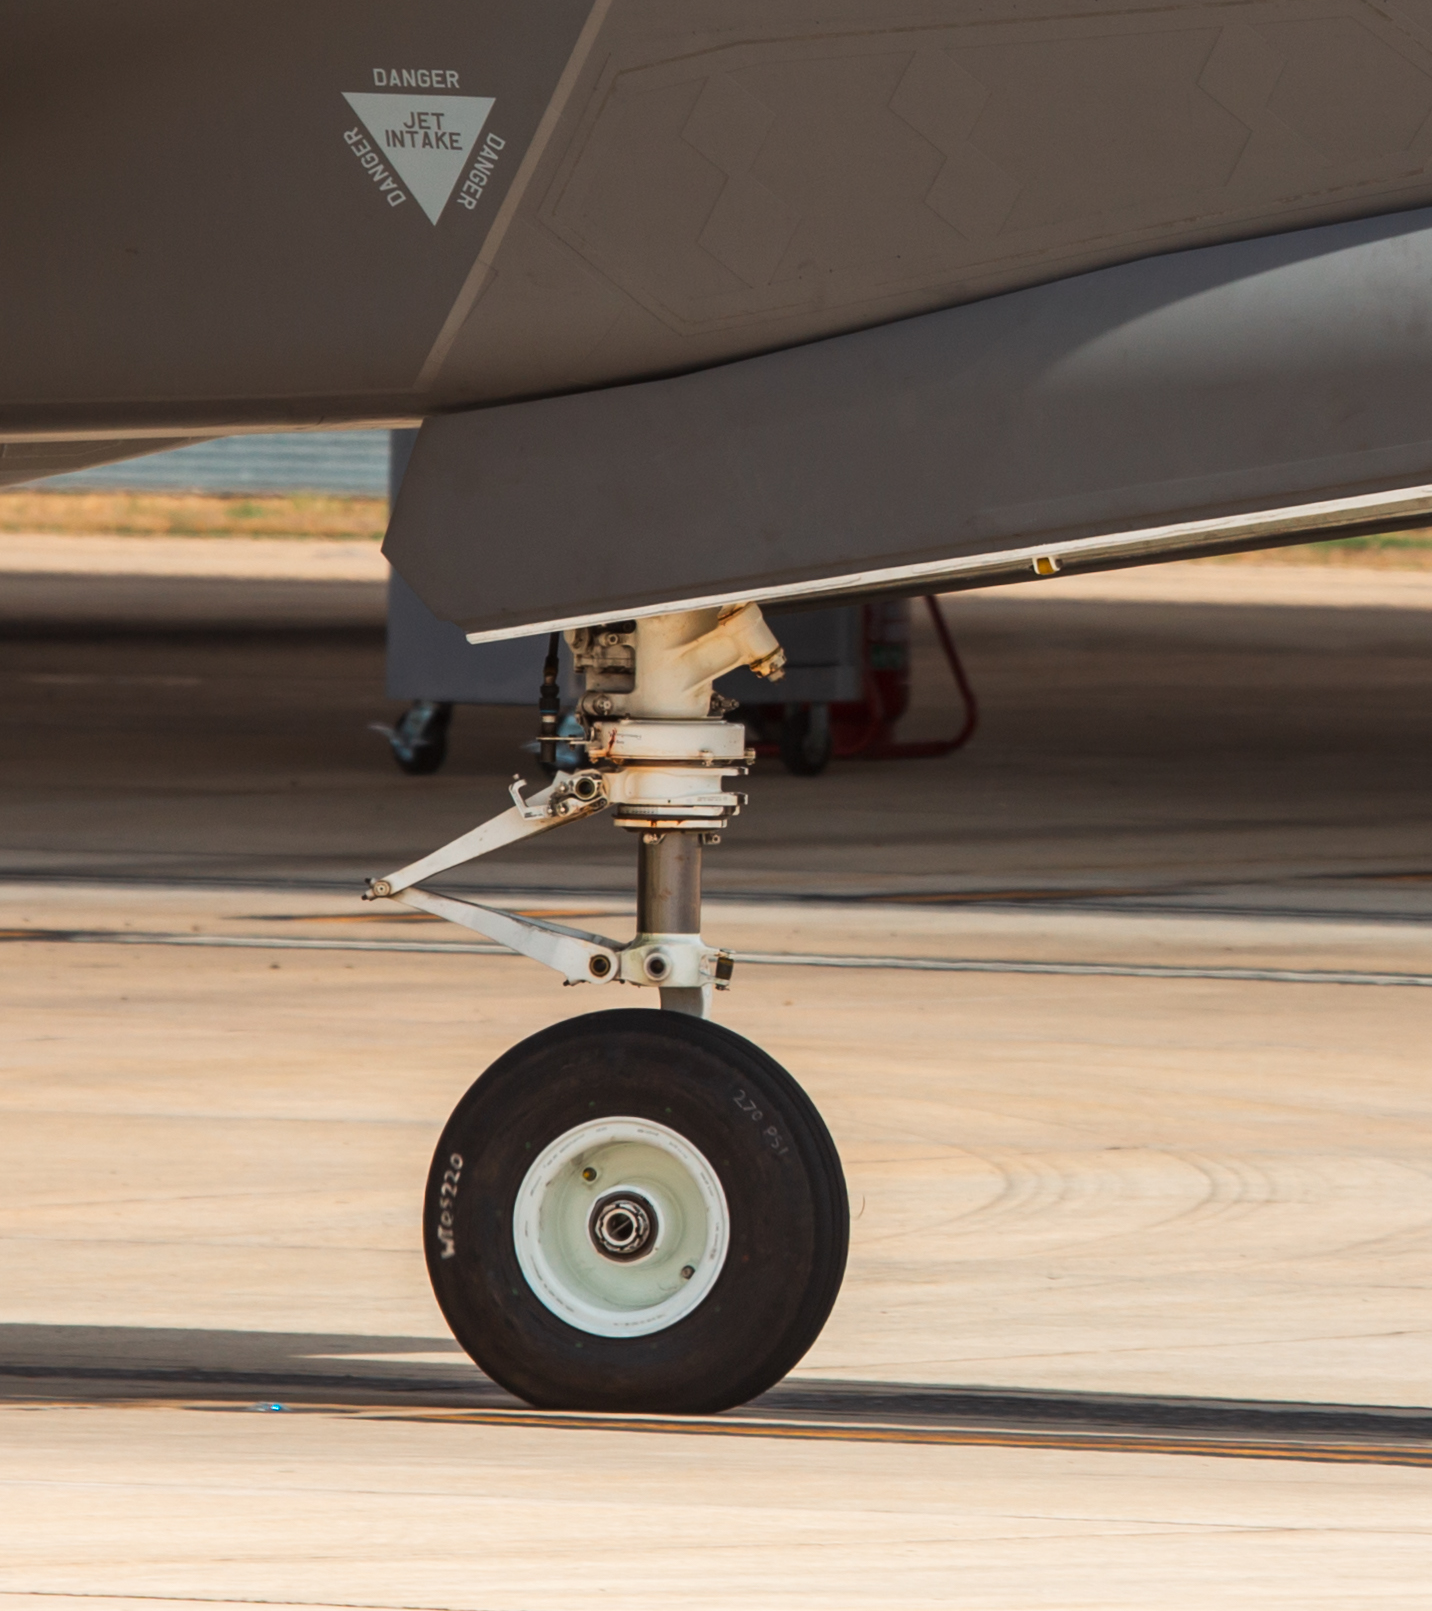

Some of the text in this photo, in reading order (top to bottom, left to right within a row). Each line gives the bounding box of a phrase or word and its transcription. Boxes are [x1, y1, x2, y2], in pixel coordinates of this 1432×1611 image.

[372, 68, 460, 89] DANGER
[403, 111, 445, 130] JET
[385, 130, 463, 151] INTAKE
[343, 126, 407, 207] DANGER
[456, 132, 506, 211] DANGER
[733, 1089, 764, 1121] 270
